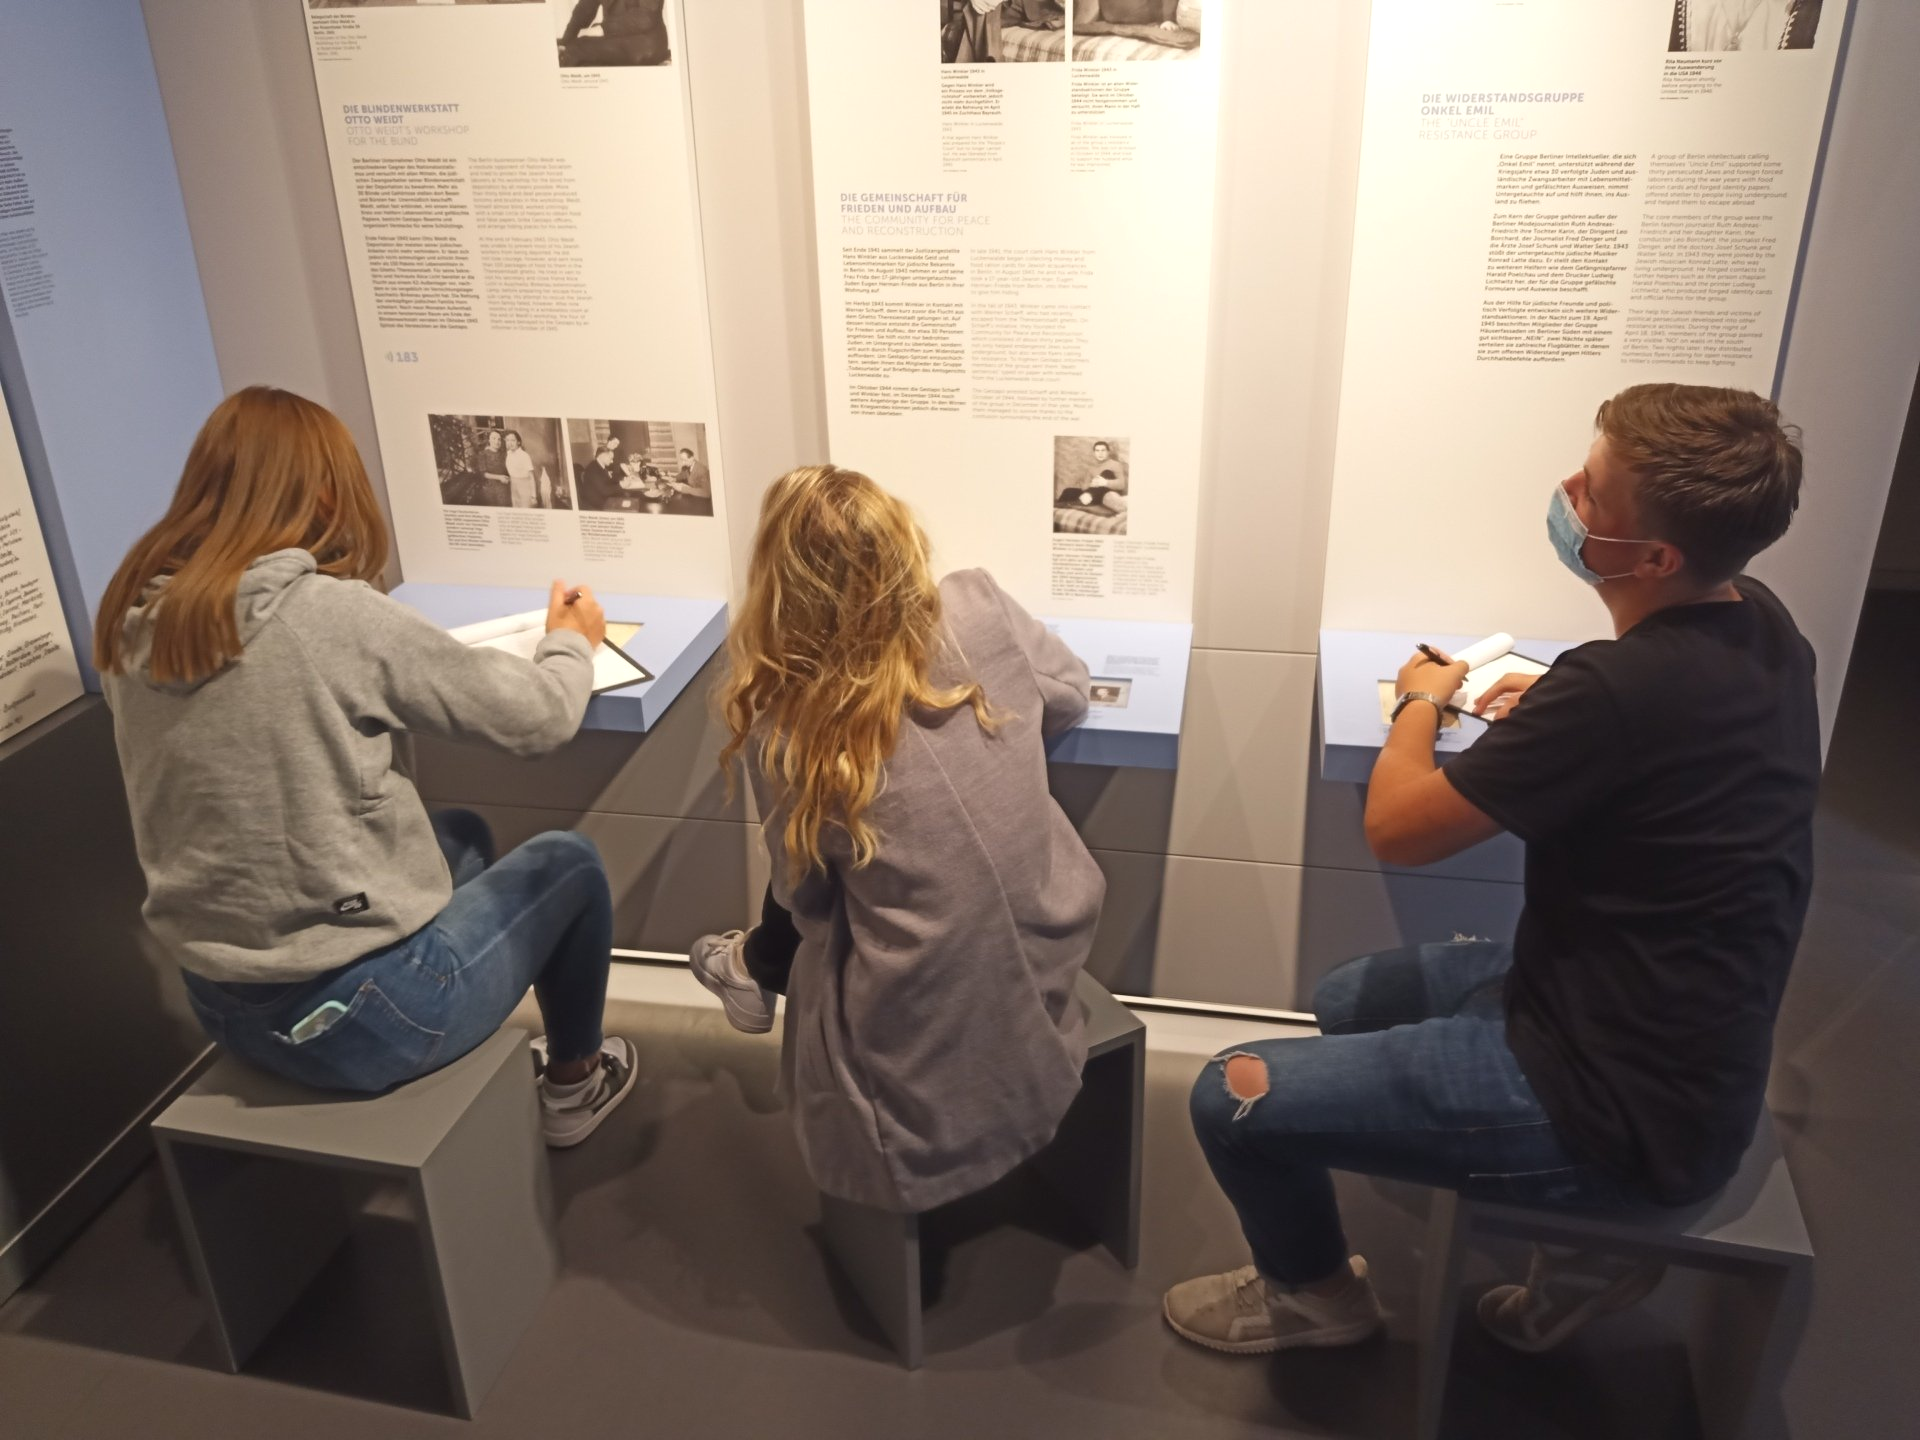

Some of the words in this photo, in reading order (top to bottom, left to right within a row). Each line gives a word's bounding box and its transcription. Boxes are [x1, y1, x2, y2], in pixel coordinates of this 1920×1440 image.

[1422, 94, 1440, 103] DIE
[1446, 92, 1584, 103] WIDERSTANDSGRUPPE
[343, 105, 359, 114] DIE
[361, 104, 460, 114] BLINDENWERKSTATT
[1421, 106, 1462, 115] ONKEL
[1466, 106, 1494, 115] EMIL
[344, 116, 371, 124] OTTO
[373, 116, 404, 124] WEIDT
[346, 126, 372, 135] OTTO
[414, 126, 469, 134] WORKSHOP
[1419, 130, 1488, 140] RESISTANCE
[1493, 130, 1538, 140] GROUP
[348, 137, 362, 146] FOR
[364, 137, 388, 145] THE
[391, 136, 418, 145] BLIND
[840, 194, 858, 202] DIE
[860, 194, 944, 202] GEMEINSCHAFT
[947, 192, 968, 202] FÜR
[841, 204, 884, 213] FRIEDEN
[888, 204, 911, 213] UND
[915, 205, 956, 213] AUFBAU
[842, 216, 860, 224] THE
[864, 216, 928, 224] COMMUNITY
[933, 216, 954, 224] FOR
[958, 216, 990, 225] PEACE
[842, 227, 864, 235] AND
[867, 227, 964, 236] RECONSTRUCTION
[396, 352, 418, 362] 183
